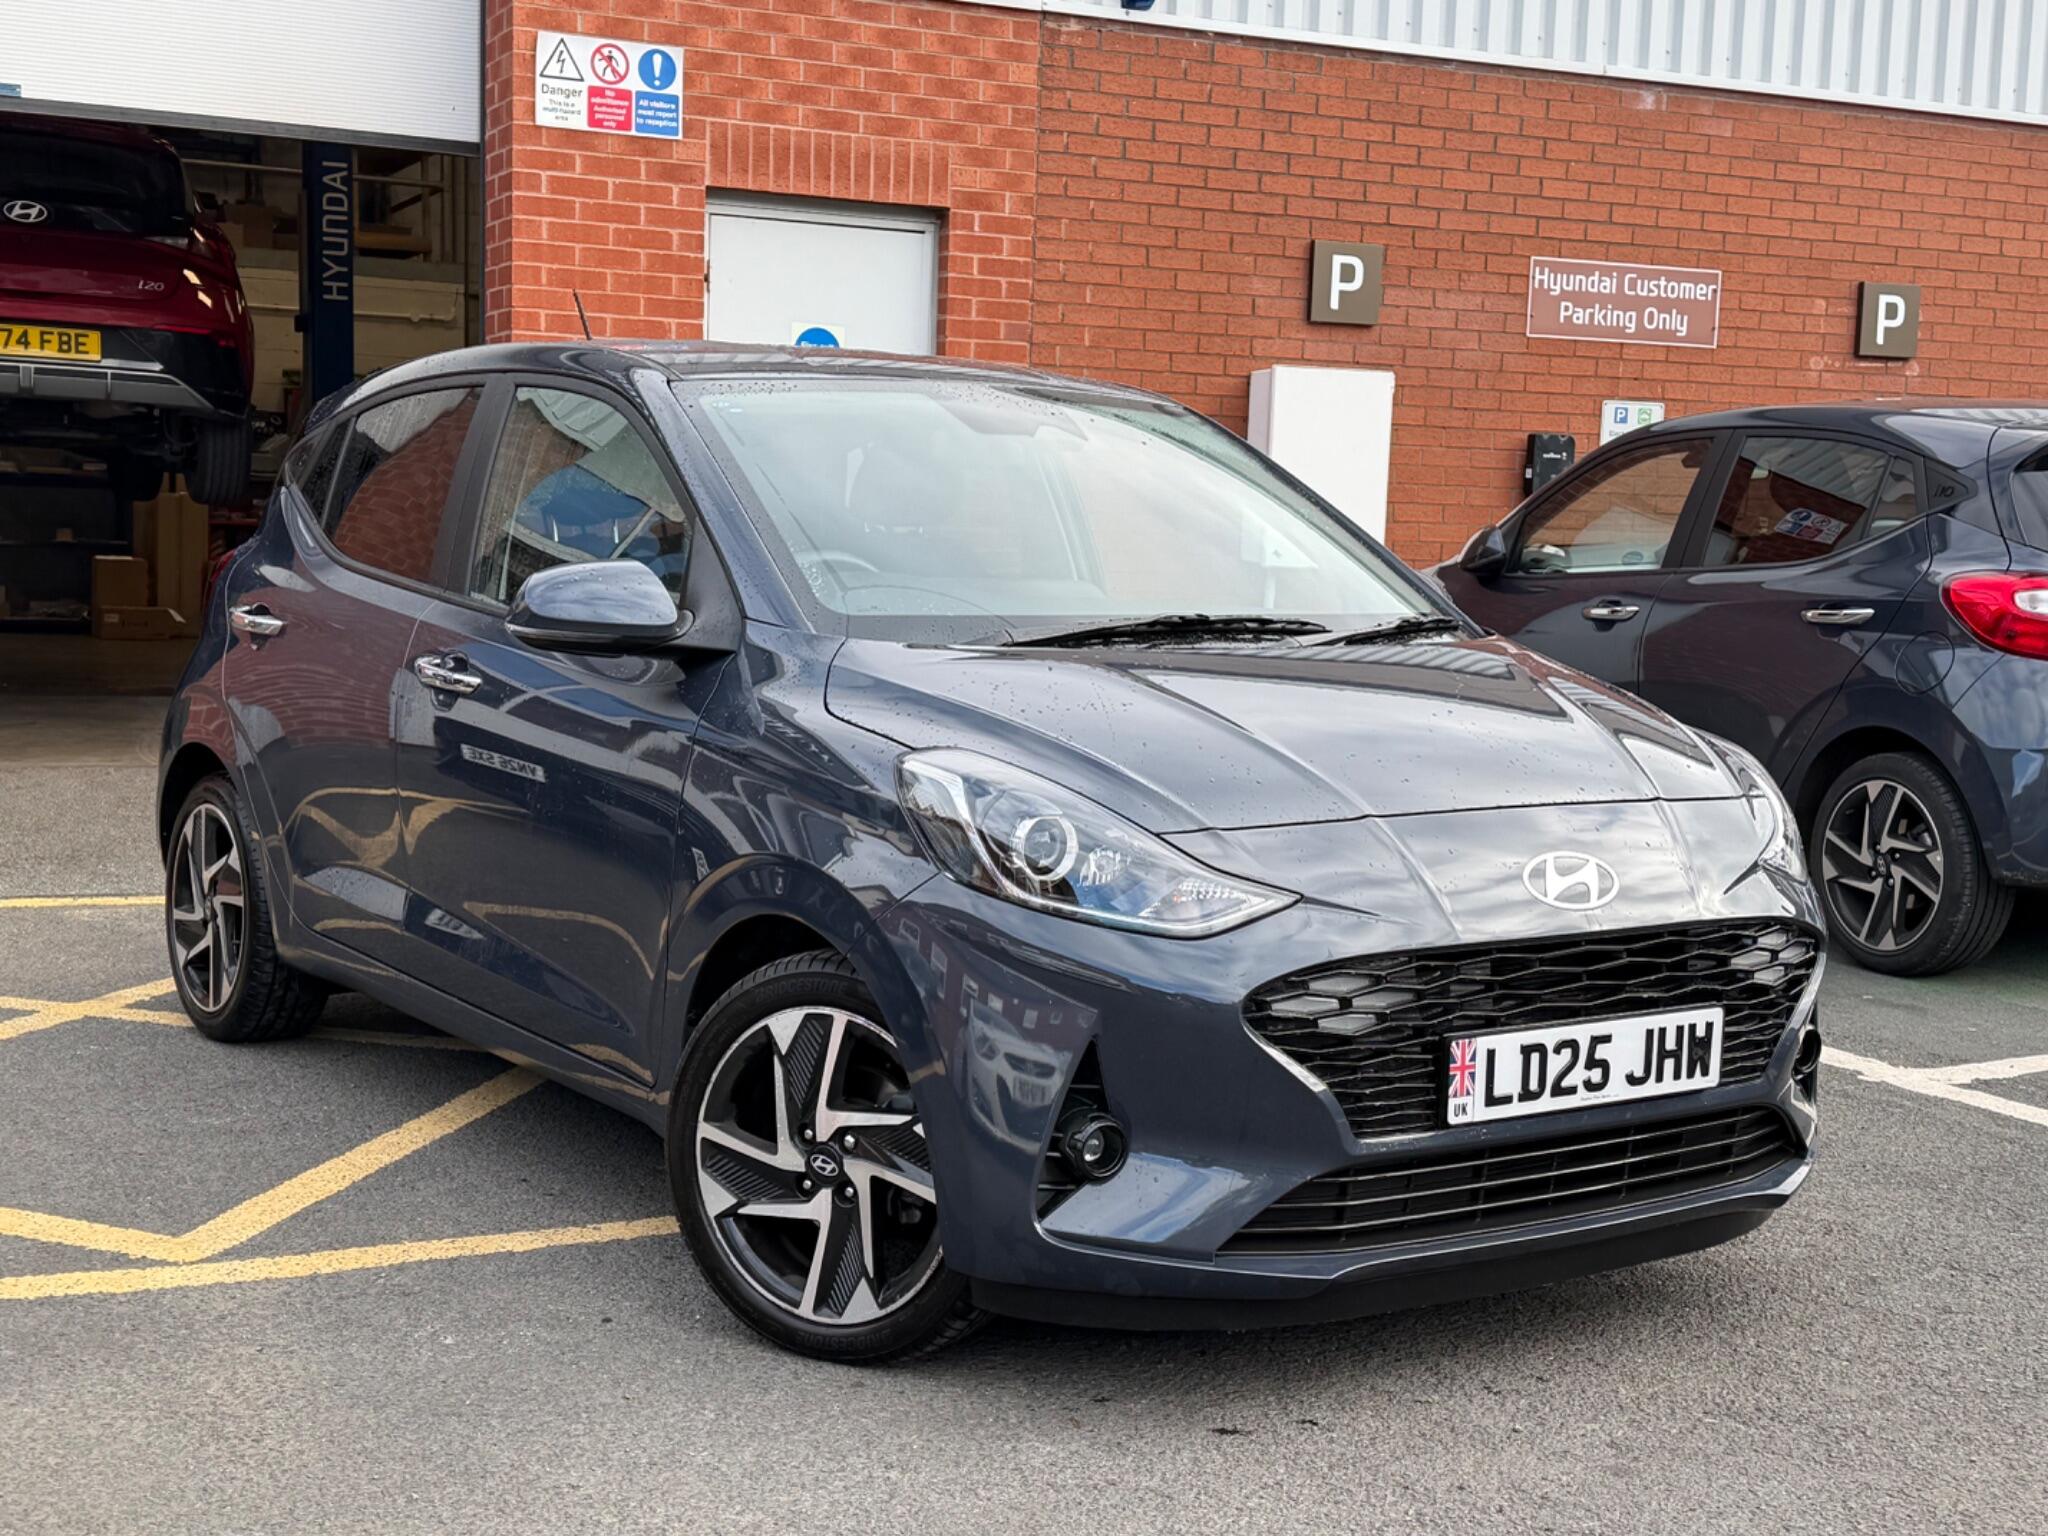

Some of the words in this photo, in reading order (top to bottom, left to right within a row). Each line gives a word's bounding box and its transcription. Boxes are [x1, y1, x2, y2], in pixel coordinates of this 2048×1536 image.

[541, 83, 583, 99] Danger
[322, 161, 349, 301] HYUNDAI
[1330, 254, 1365, 311] P
[1534, 266, 1618, 296] Hyundai
[1624, 273, 1718, 302] Customer
[1559, 301, 1637, 334] Parking
[1643, 306, 1689, 337] Only
[1876, 293, 1906, 346] P
[0, 328, 31, 351] 74
[40, 330, 90, 355] FBE
[1616, 408, 1626, 422] P
[1484, 1034, 1613, 1108] LD25
[1625, 1021, 1715, 1087] JHW
[1453, 1102, 1468, 1117] UK
